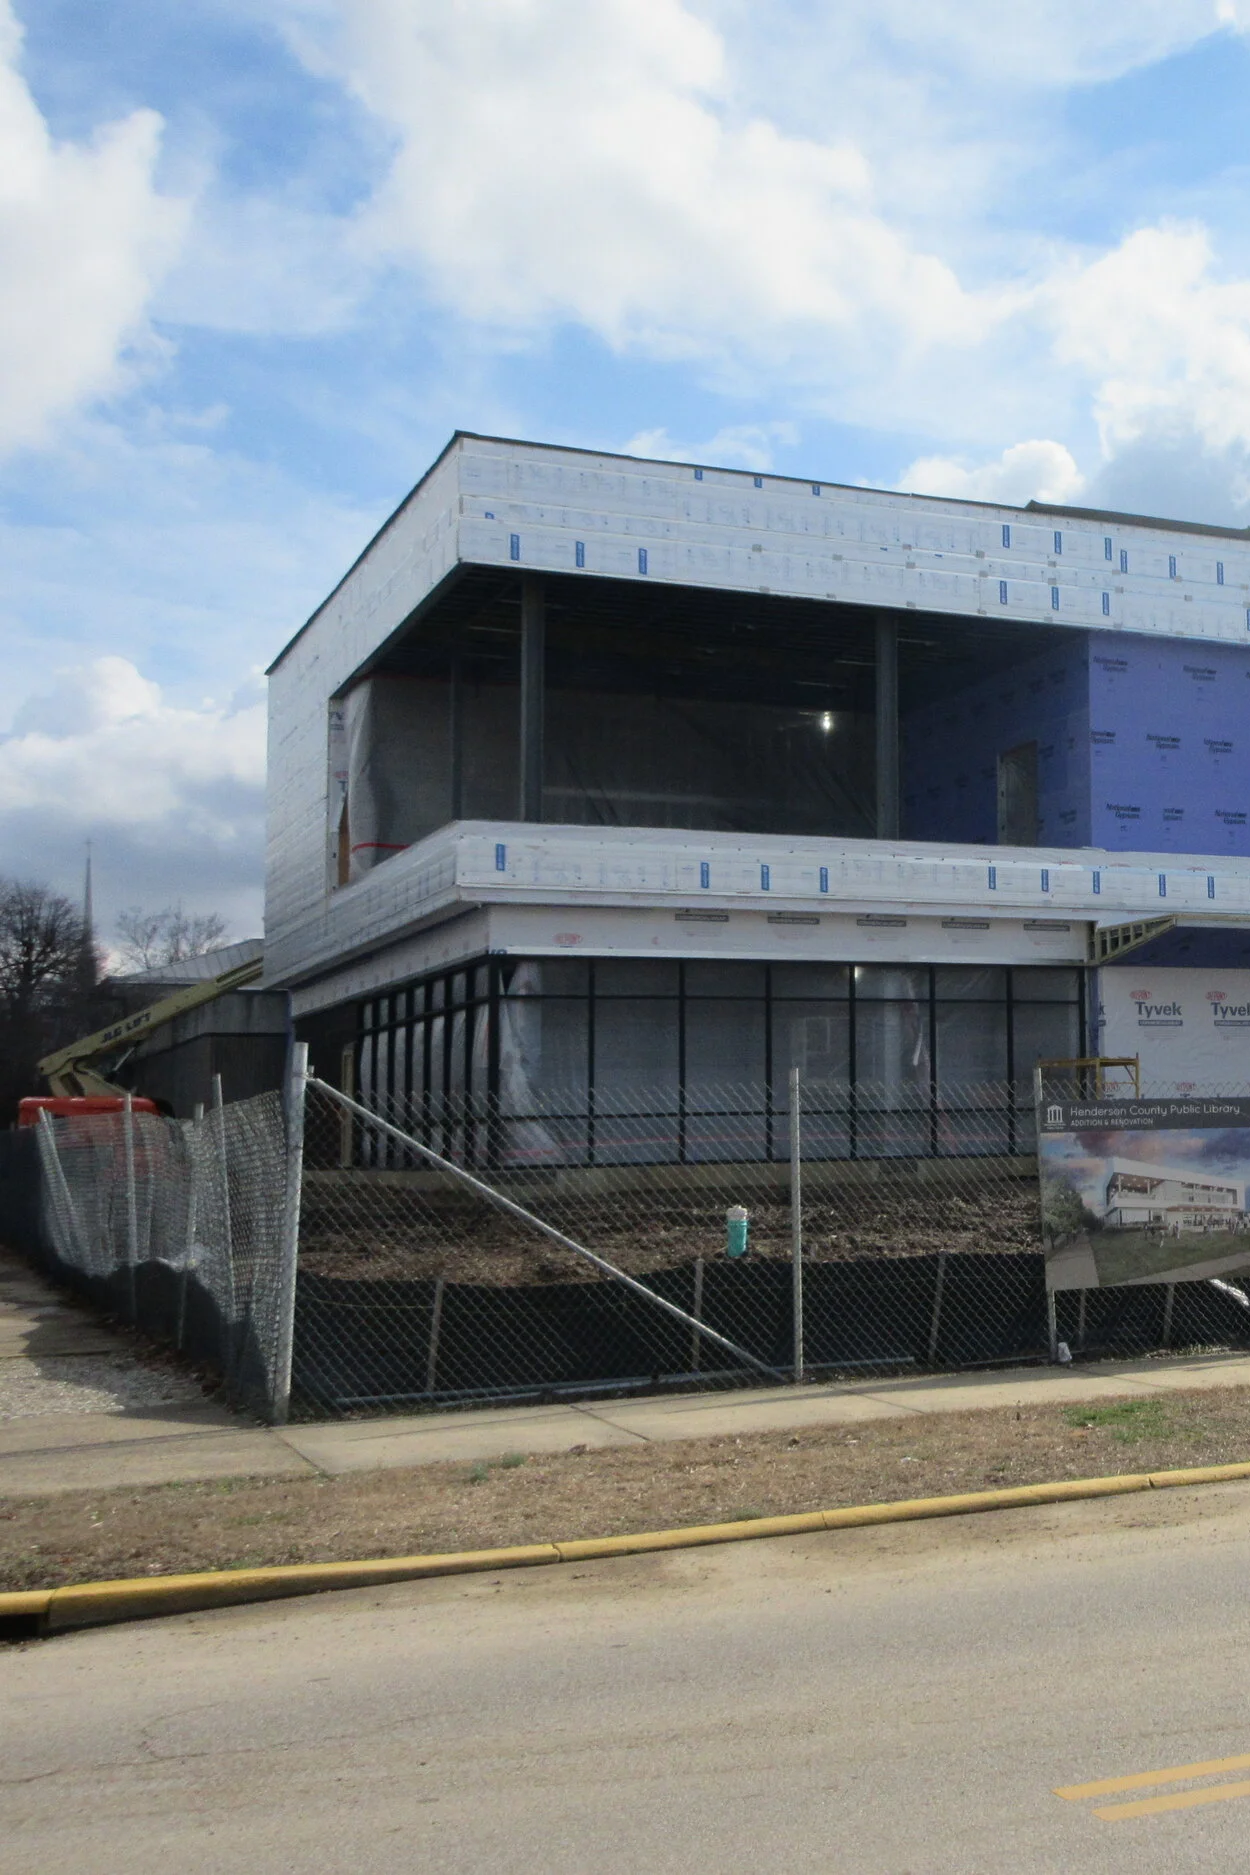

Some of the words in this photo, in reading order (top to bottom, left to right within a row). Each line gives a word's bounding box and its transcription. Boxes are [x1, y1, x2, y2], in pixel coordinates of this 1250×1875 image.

[1135, 1001, 1182, 1018] Tyvek
[1071, 1107, 1127, 1117] Henderson
[1129, 1106, 1167, 1117] County
[1170, 1104, 1201, 1114] Public
[1203, 1103, 1240, 1115] Library
[1071, 1119, 1104, 1127] ADDITION
[1111, 1118, 1153, 1126] RENOVATION
